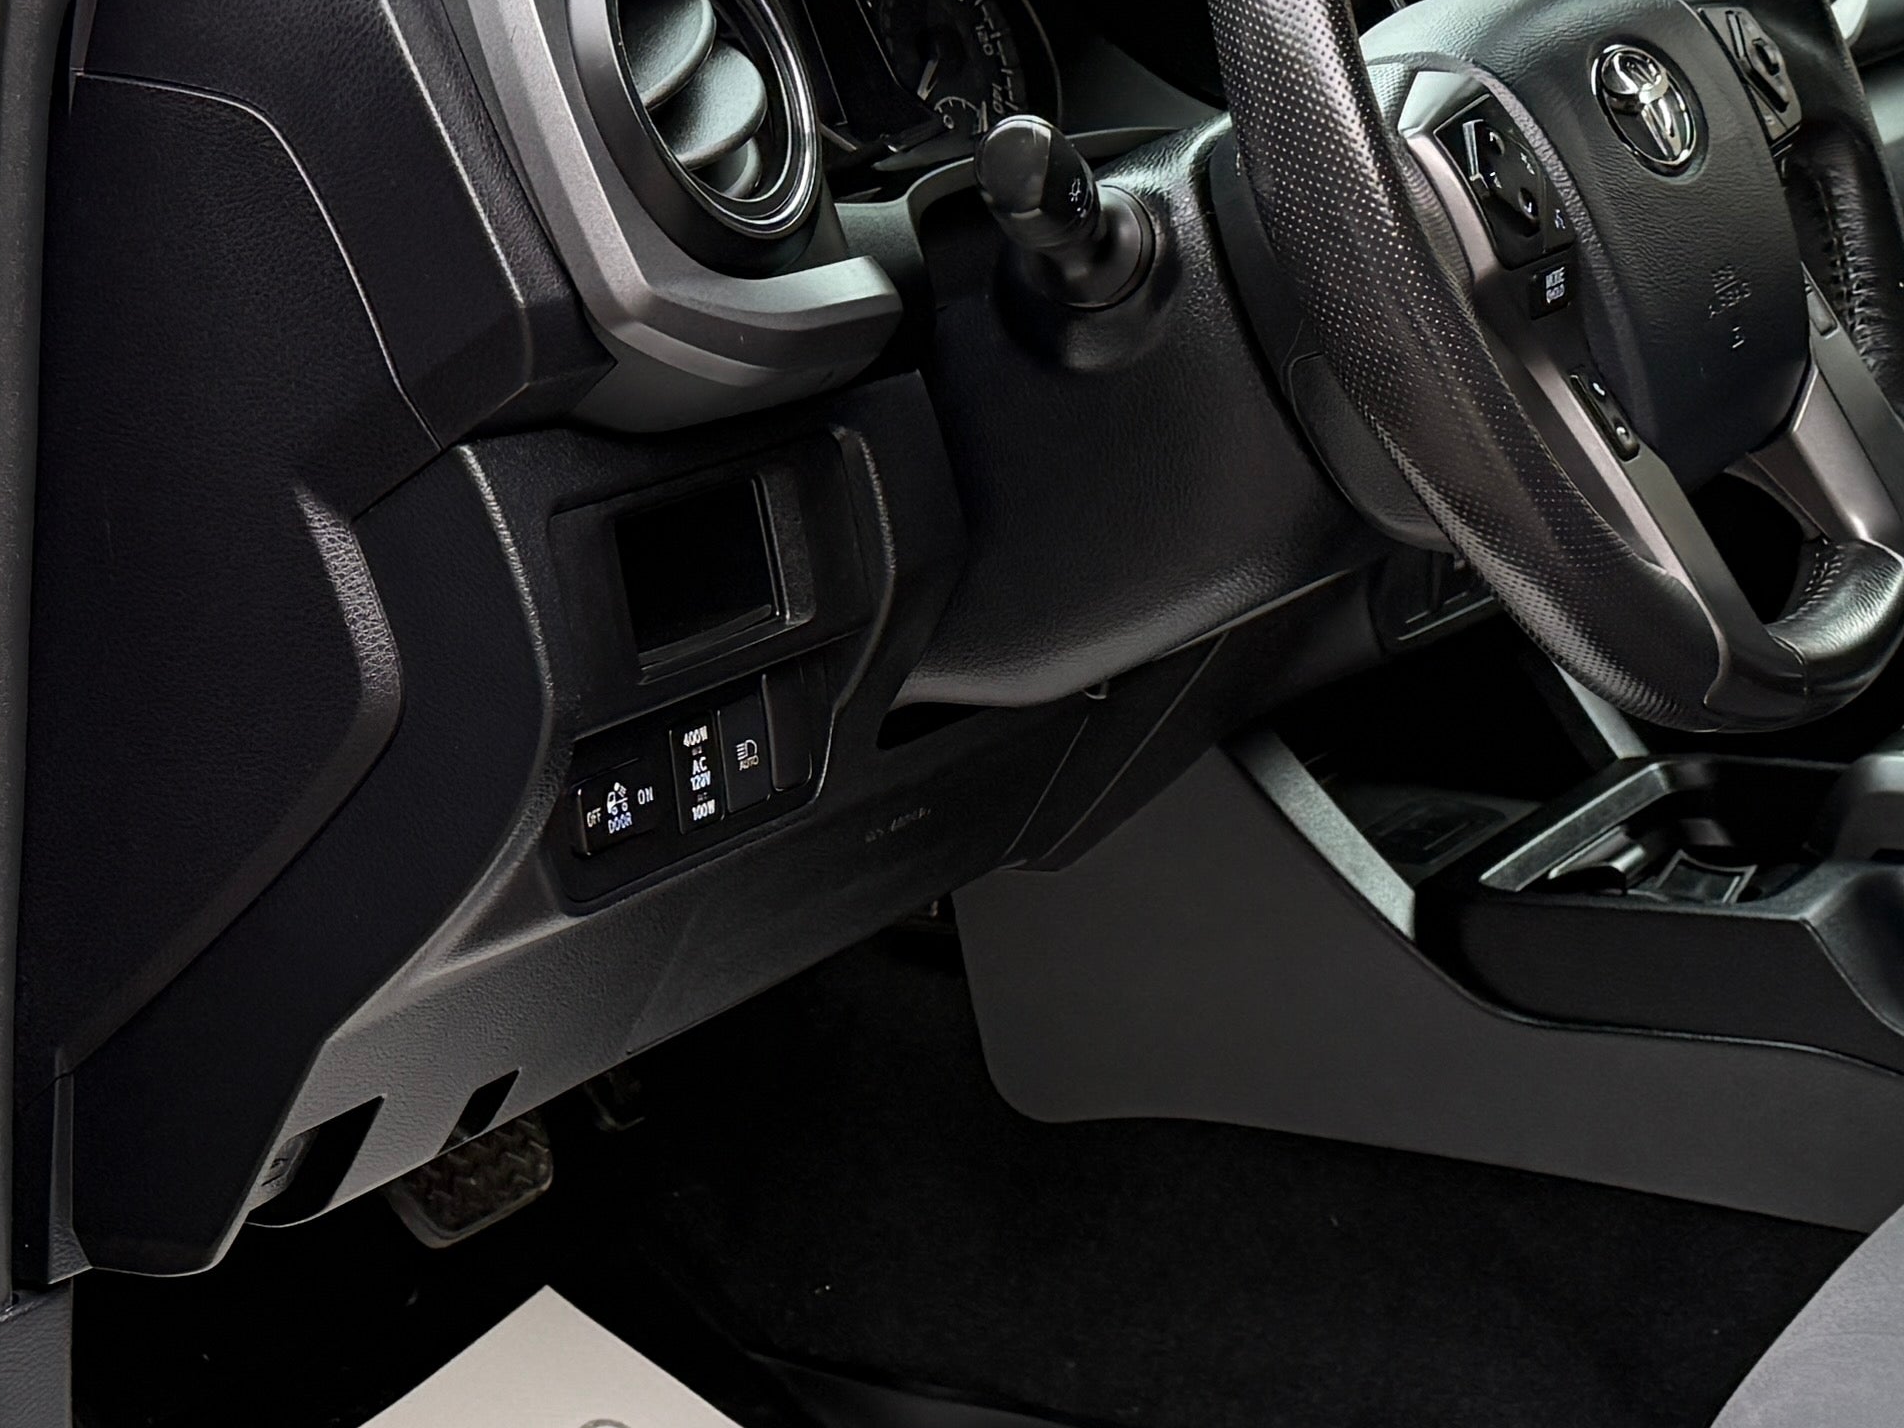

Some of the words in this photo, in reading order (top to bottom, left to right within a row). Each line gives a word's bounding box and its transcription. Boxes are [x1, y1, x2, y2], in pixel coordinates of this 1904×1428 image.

[974, 25, 994, 56] 120
[683, 725, 708, 747] 400W
[692, 756, 708, 775] AC
[739, 755, 759, 771] AUTO
[690, 770, 711, 791] 120V
[637, 786, 654, 805] ON
[587, 807, 601, 828] OFF
[691, 799, 715, 821] 100W
[607, 811, 633, 834] DOOR
